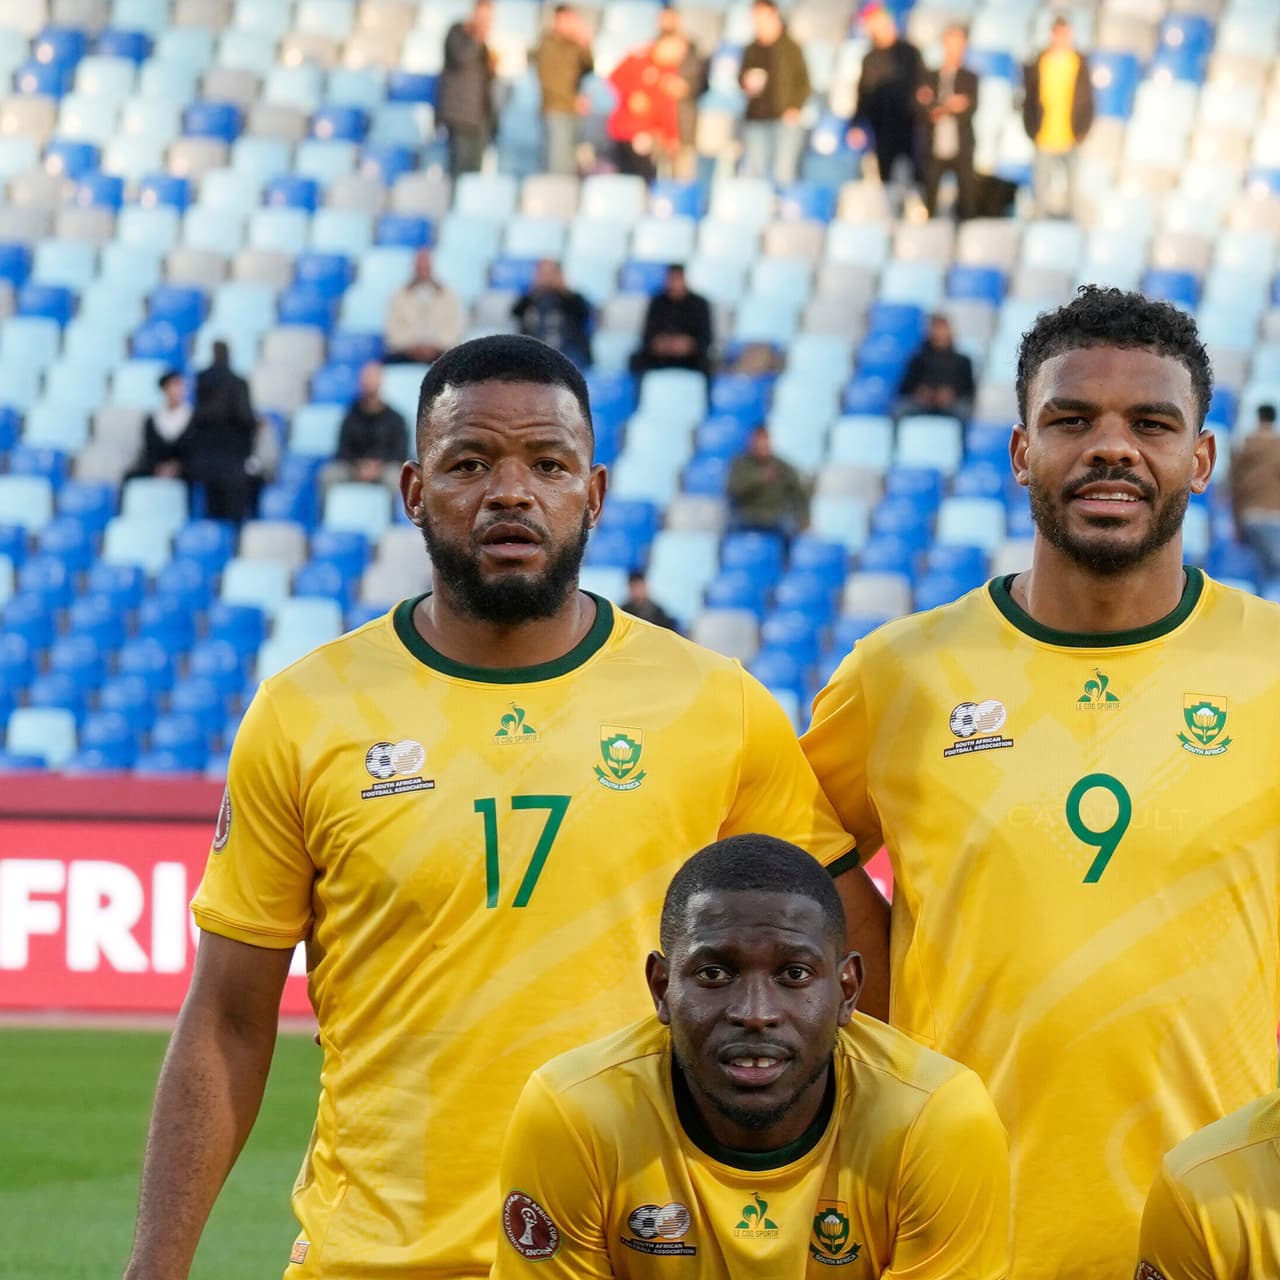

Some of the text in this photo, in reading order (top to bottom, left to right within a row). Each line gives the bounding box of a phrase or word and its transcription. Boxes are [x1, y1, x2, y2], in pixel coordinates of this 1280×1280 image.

[599, 777, 641, 790] SOUTH AFRICA
[1183, 743, 1228, 755] SOUTH AFRICA
[475, 795, 570, 908] 17
[1066, 774, 1131, 883] 9
[0, 857, 200, 975] FRI
